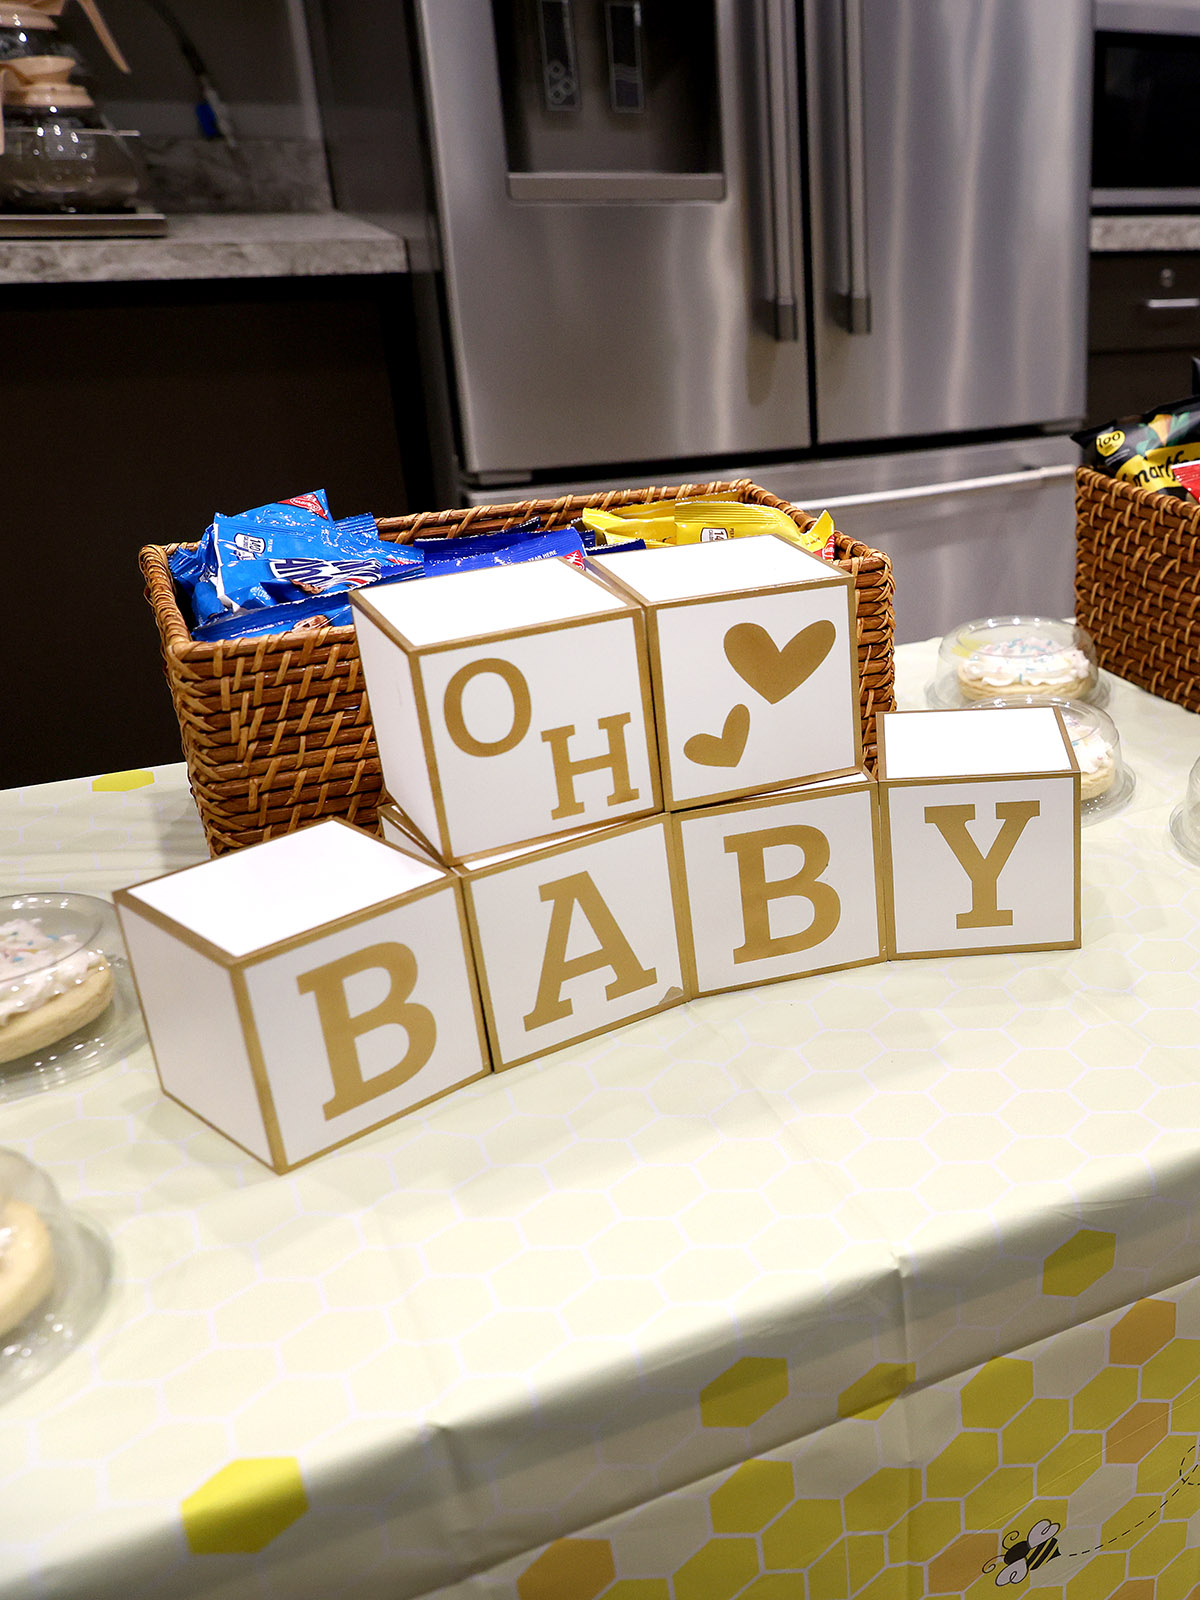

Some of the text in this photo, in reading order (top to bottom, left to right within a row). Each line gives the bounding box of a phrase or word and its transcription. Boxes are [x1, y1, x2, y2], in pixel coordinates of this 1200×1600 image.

[1097, 432, 1121, 448] 100
[443, 657, 642, 821] OH
[296, 801, 1041, 1122] BABY
